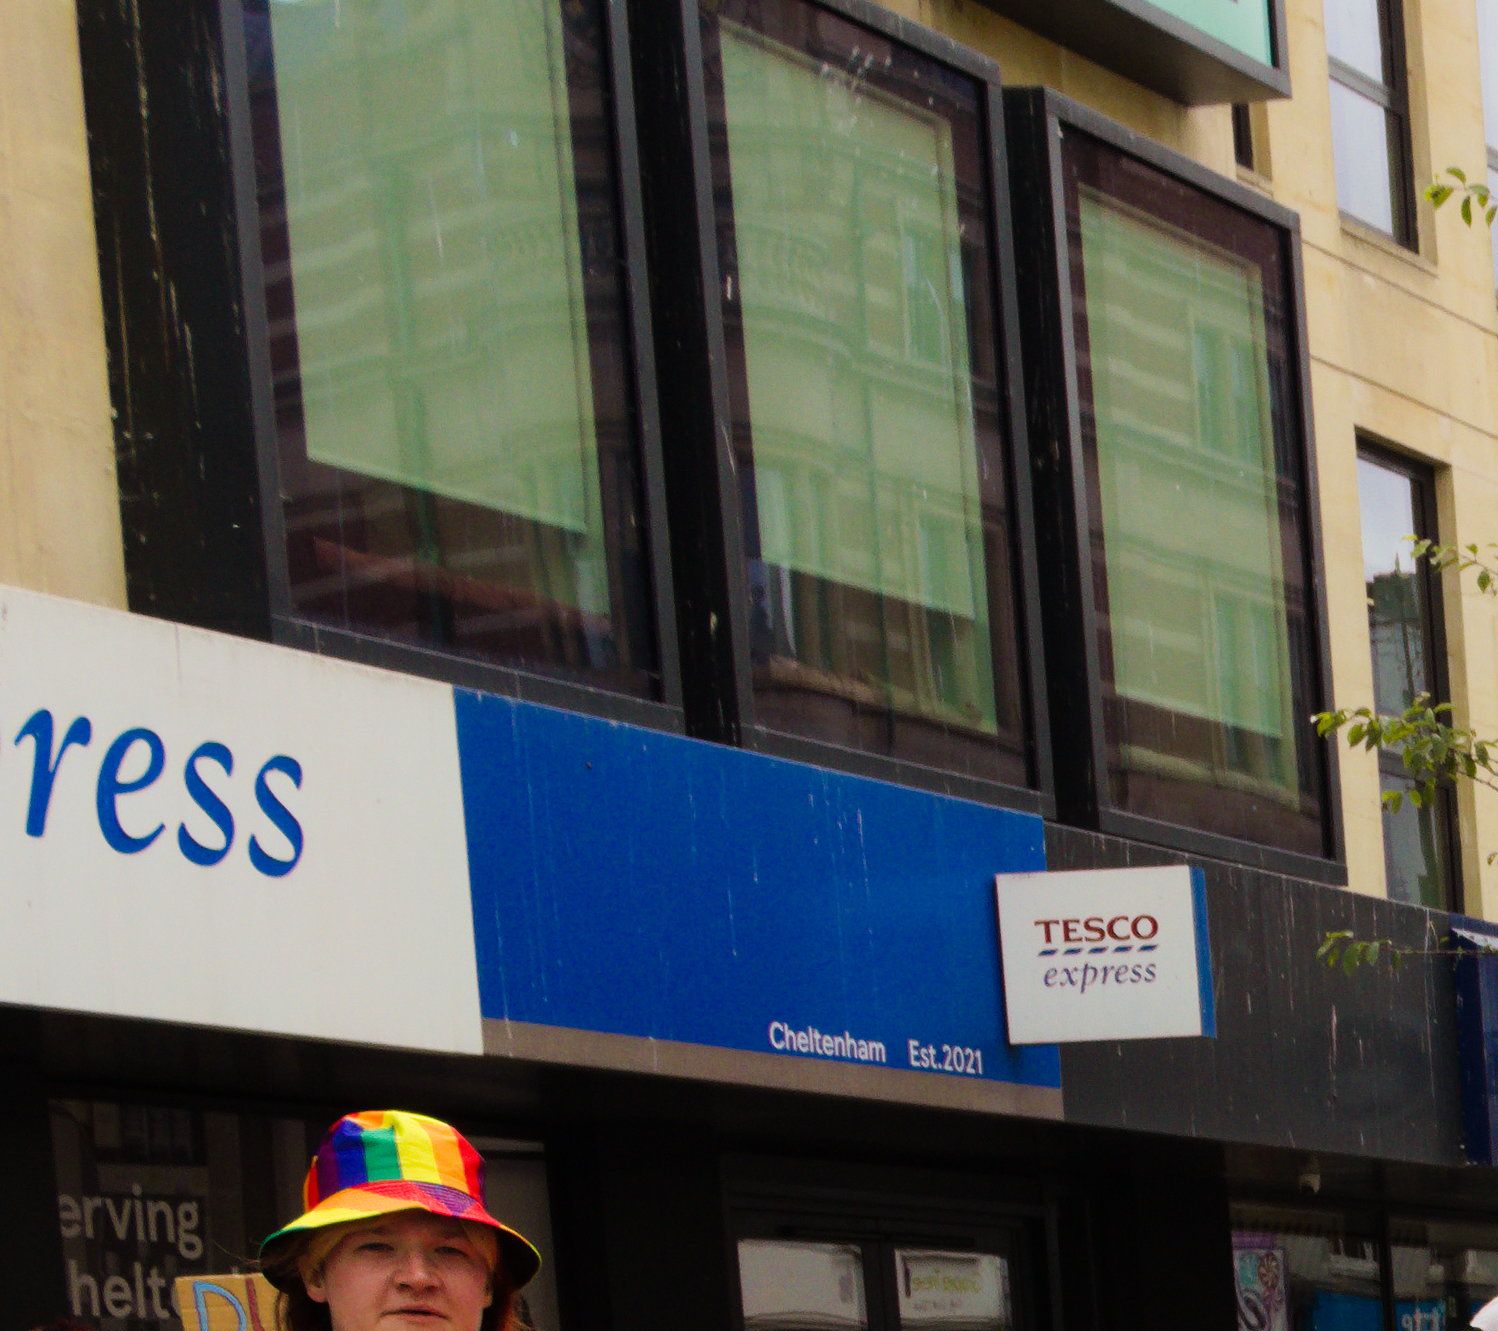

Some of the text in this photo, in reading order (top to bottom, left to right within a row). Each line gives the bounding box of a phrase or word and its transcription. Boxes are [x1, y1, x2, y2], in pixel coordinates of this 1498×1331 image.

[14, 708, 304, 878] ress
[1034, 914, 1159, 944] TESCO
[1042, 961, 1157, 994] express
[768, 1020, 984, 1075] Cheltenham Est.2021
[58, 1183, 203, 1260] erving
